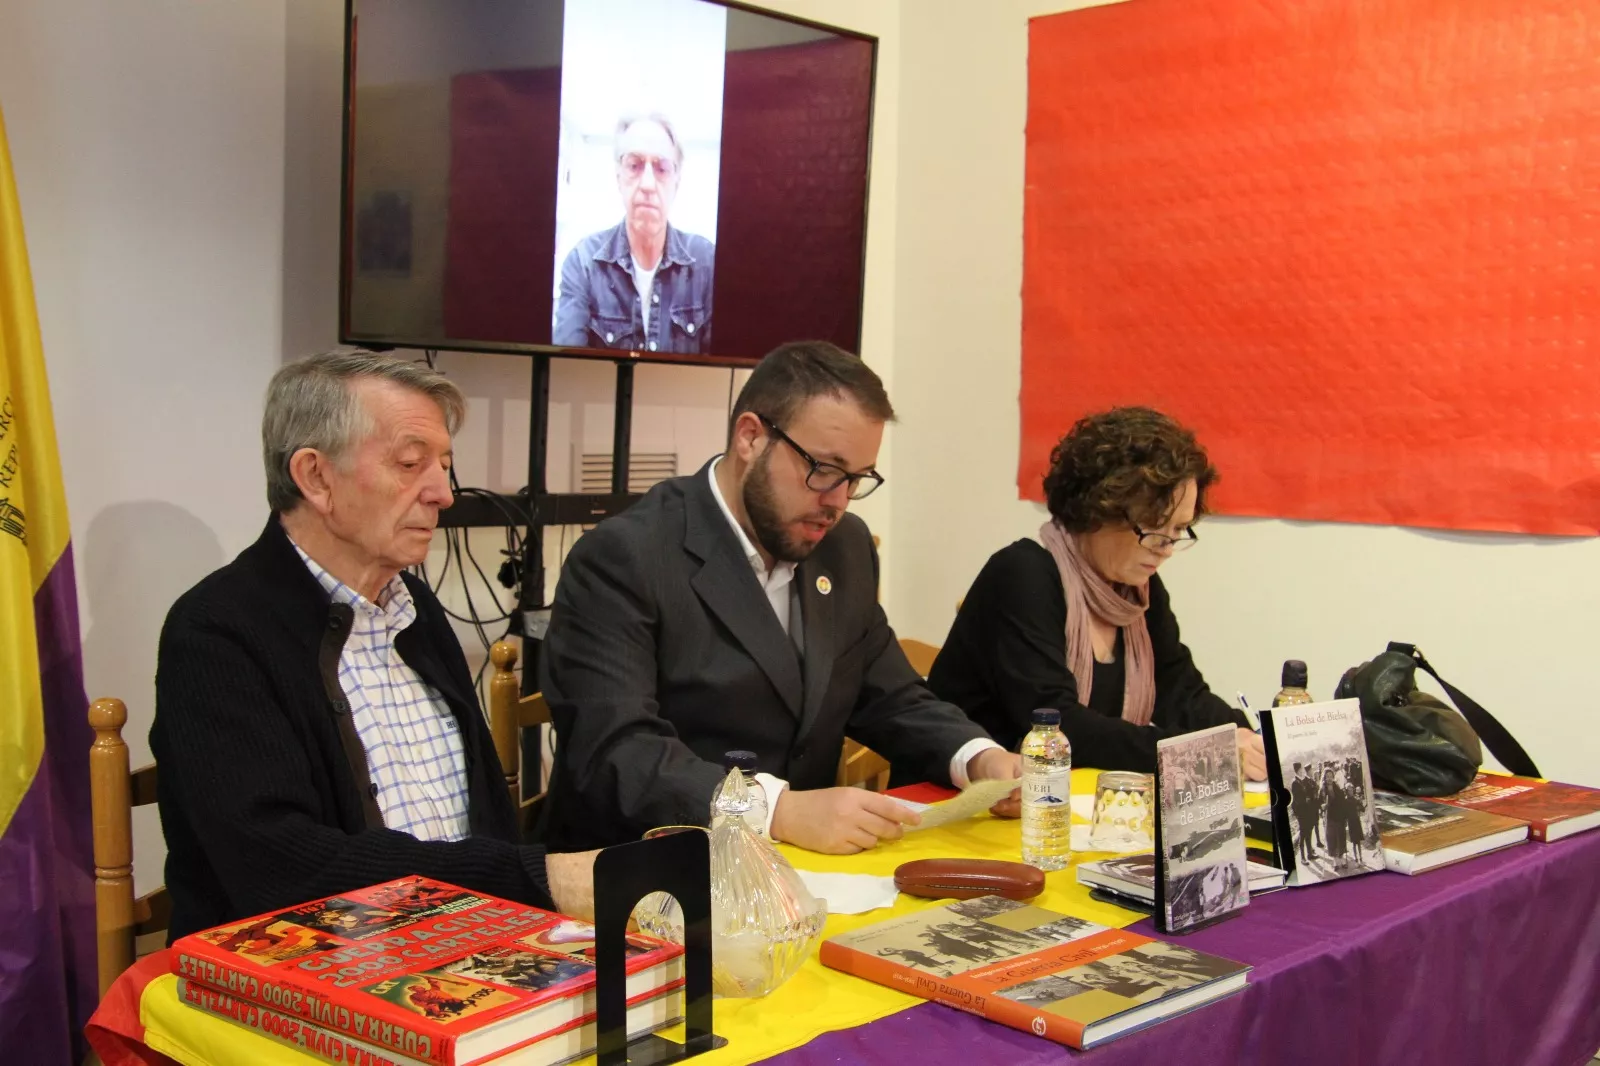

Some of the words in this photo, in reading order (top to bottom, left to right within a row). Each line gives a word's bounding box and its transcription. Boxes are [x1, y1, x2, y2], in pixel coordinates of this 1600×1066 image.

[1284, 717, 1294, 727] La
[1296, 714, 1315, 726] Bolsa
[1316, 713, 1325, 723] de
[1028, 783, 1050, 793] VERI
[1178, 791, 1194, 806] La
[1197, 779, 1230, 800] Bolsa
[1180, 810, 1194, 826] de
[1198, 799, 1237, 821] Bielsa
[297, 929, 442, 971] GUERRA
[432, 907, 517, 931] CIVIL
[318, 955, 403, 987] 2000
[401, 910, 547, 957] CARTELES
[179, 954, 259, 998] CARTELES
[1006, 959, 1063, 979] Guerra
[1059, 948, 1098, 963] Civil
[262, 982, 303, 1013] 2000
[916, 976, 937, 993] Civil
[940, 984, 972, 1005] Guerra
[306, 996, 350, 1030] CIVIL
[975, 996, 986, 1010] La
[261, 1011, 300, 1044] 2000
[353, 1011, 432, 1058] GUERRA
[302, 1026, 344, 1063] CIVIL
